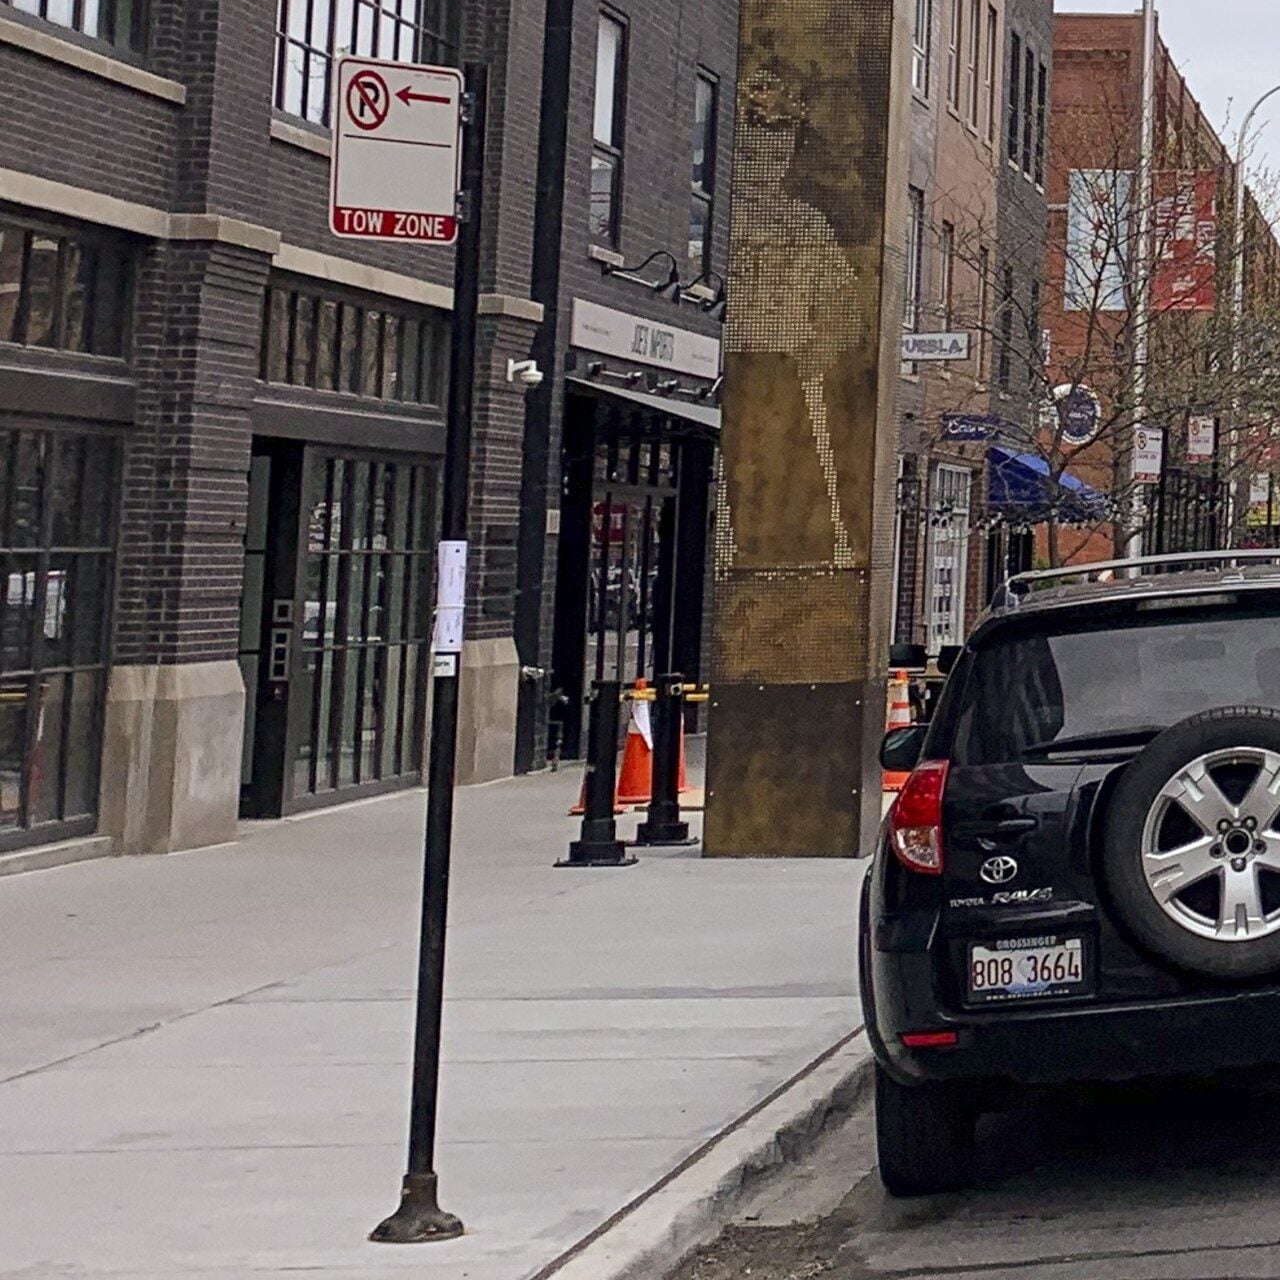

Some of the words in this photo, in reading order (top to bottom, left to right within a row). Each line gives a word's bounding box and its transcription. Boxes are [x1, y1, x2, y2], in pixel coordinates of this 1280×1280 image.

[341, 210, 384, 234] TOW
[393, 214, 446, 239] ZONE
[950, 897, 985, 908] TOYOTA
[973, 957, 1013, 988] 808
[1026, 951, 1080, 984] 3664
